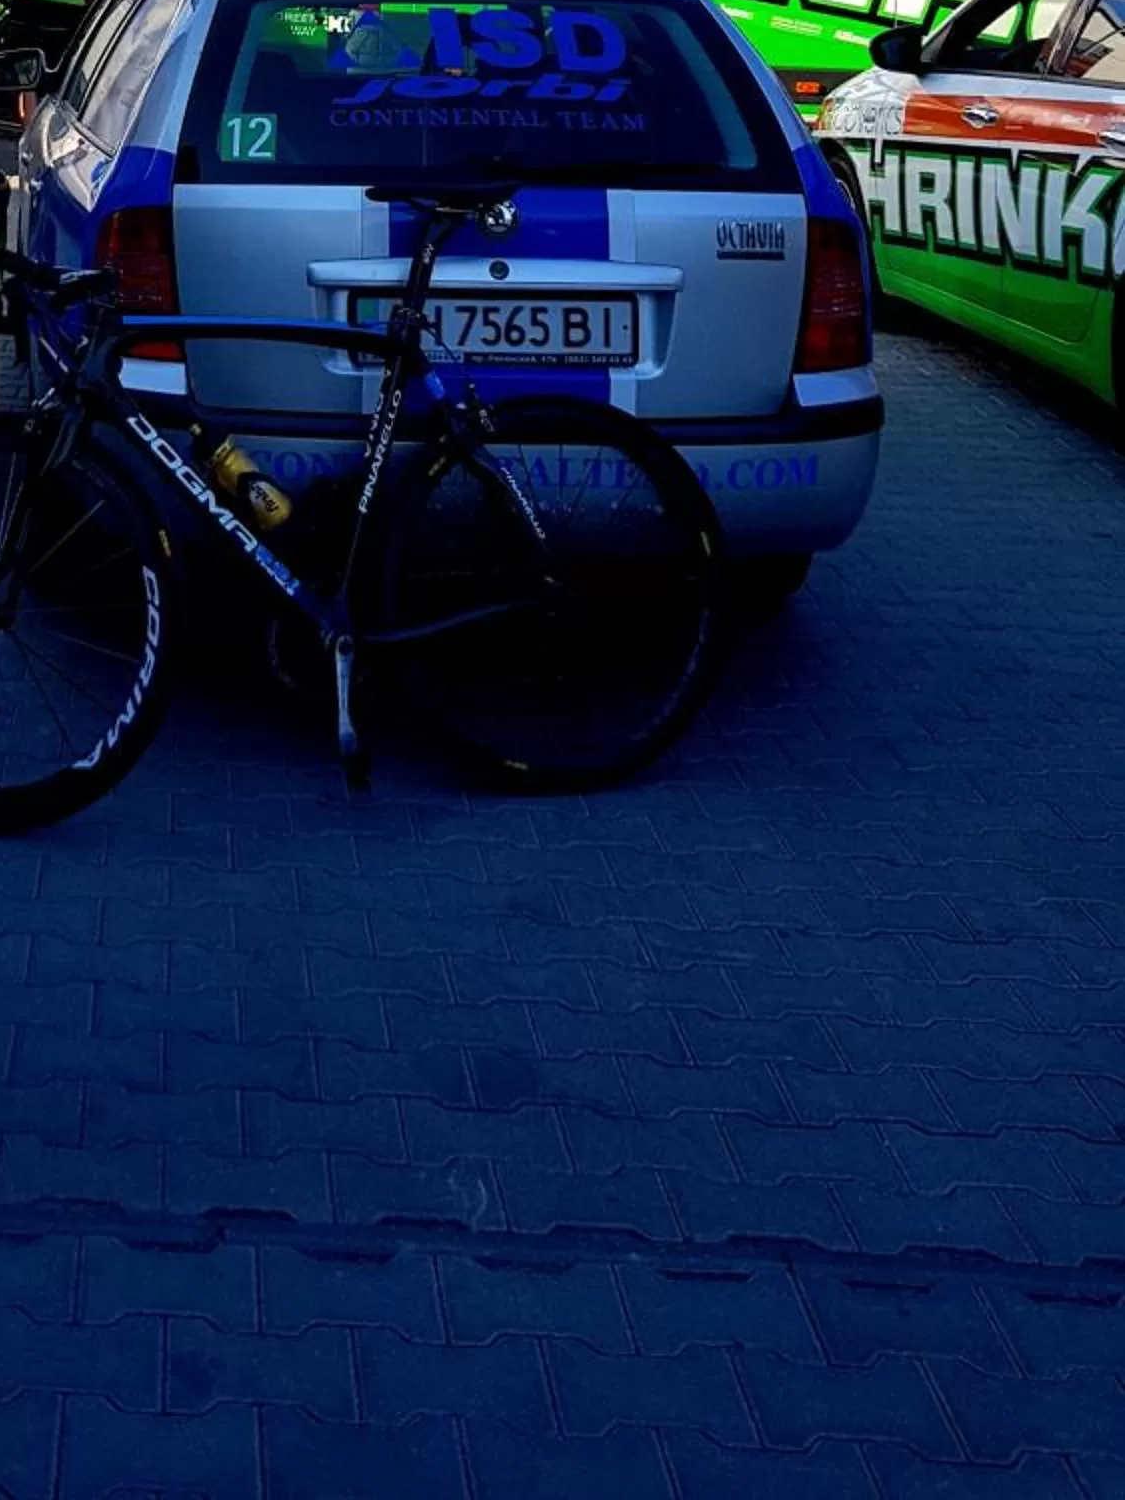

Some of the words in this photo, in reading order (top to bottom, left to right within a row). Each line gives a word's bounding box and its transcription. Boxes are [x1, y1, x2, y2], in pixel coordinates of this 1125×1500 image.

[226, 116, 275, 160] 12
[328, 107, 551, 130] CONTINENTAL
[555, 110, 647, 133] TEAM
[716, 219, 786, 249] OCTAVIA
[850, 149, 1125, 278] HRINK
[454, 305, 551, 348] 7565
[562, 306, 611, 348] BI
[124, 412, 259, 554] DOGMA
[357, 389, 403, 515] PINARELLO
[70, 564, 162, 770] CORIMA
